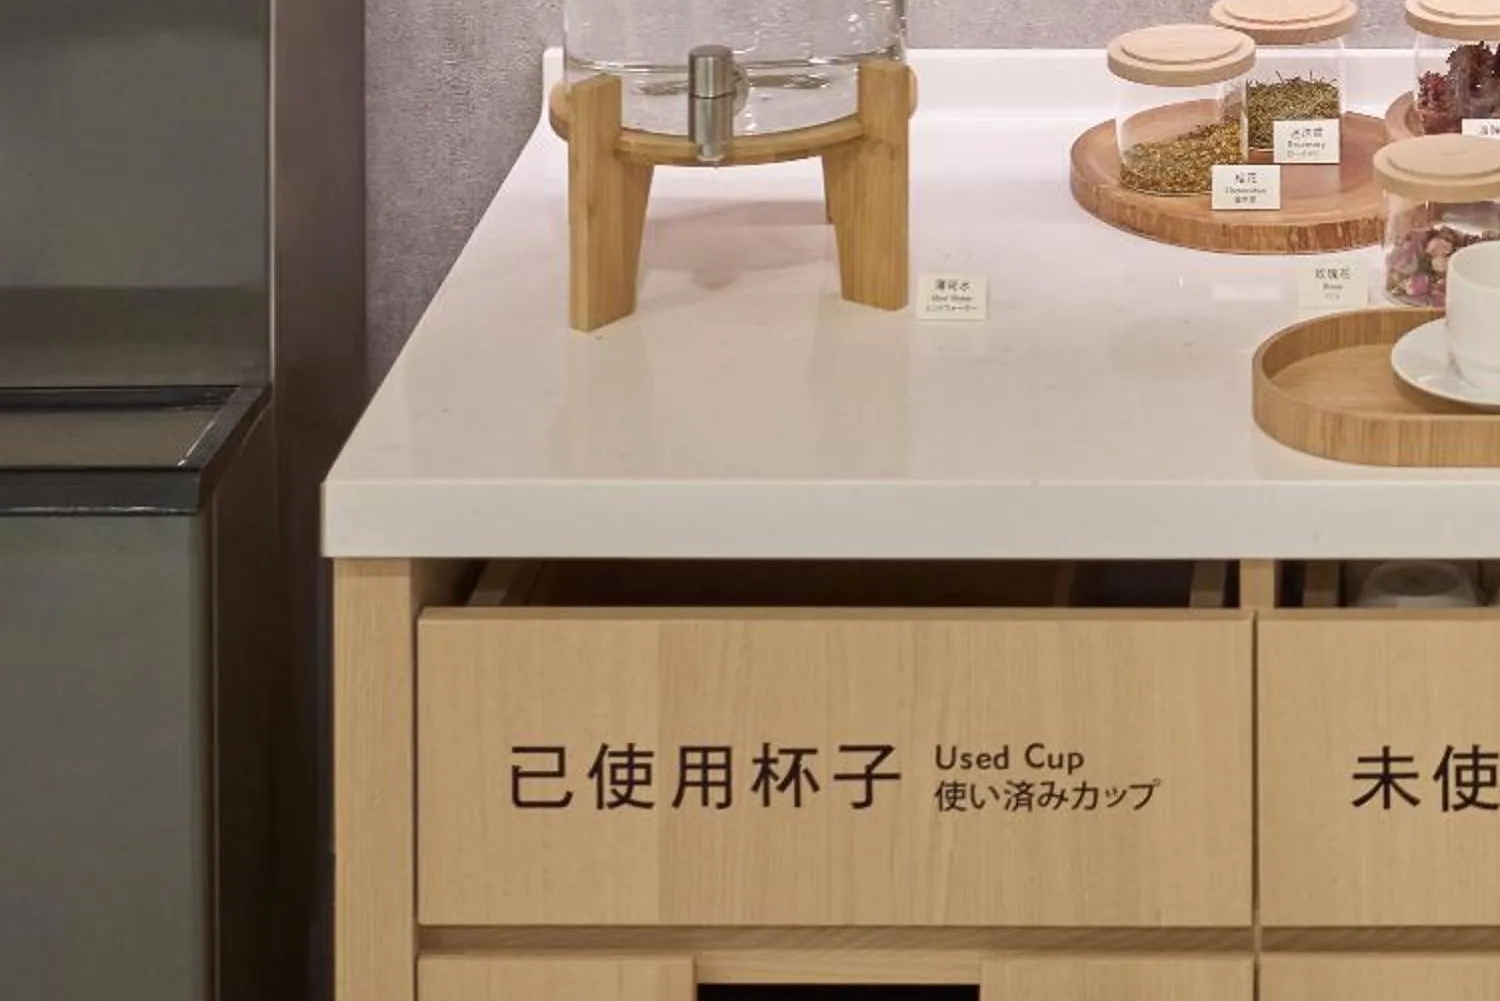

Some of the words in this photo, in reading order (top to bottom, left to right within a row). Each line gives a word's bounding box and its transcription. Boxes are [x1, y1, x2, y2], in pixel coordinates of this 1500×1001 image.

[936, 745, 1009, 770] Used
[1025, 743, 1084, 775] Cup
[934, 780, 1160, 812] 使い済みカップ
